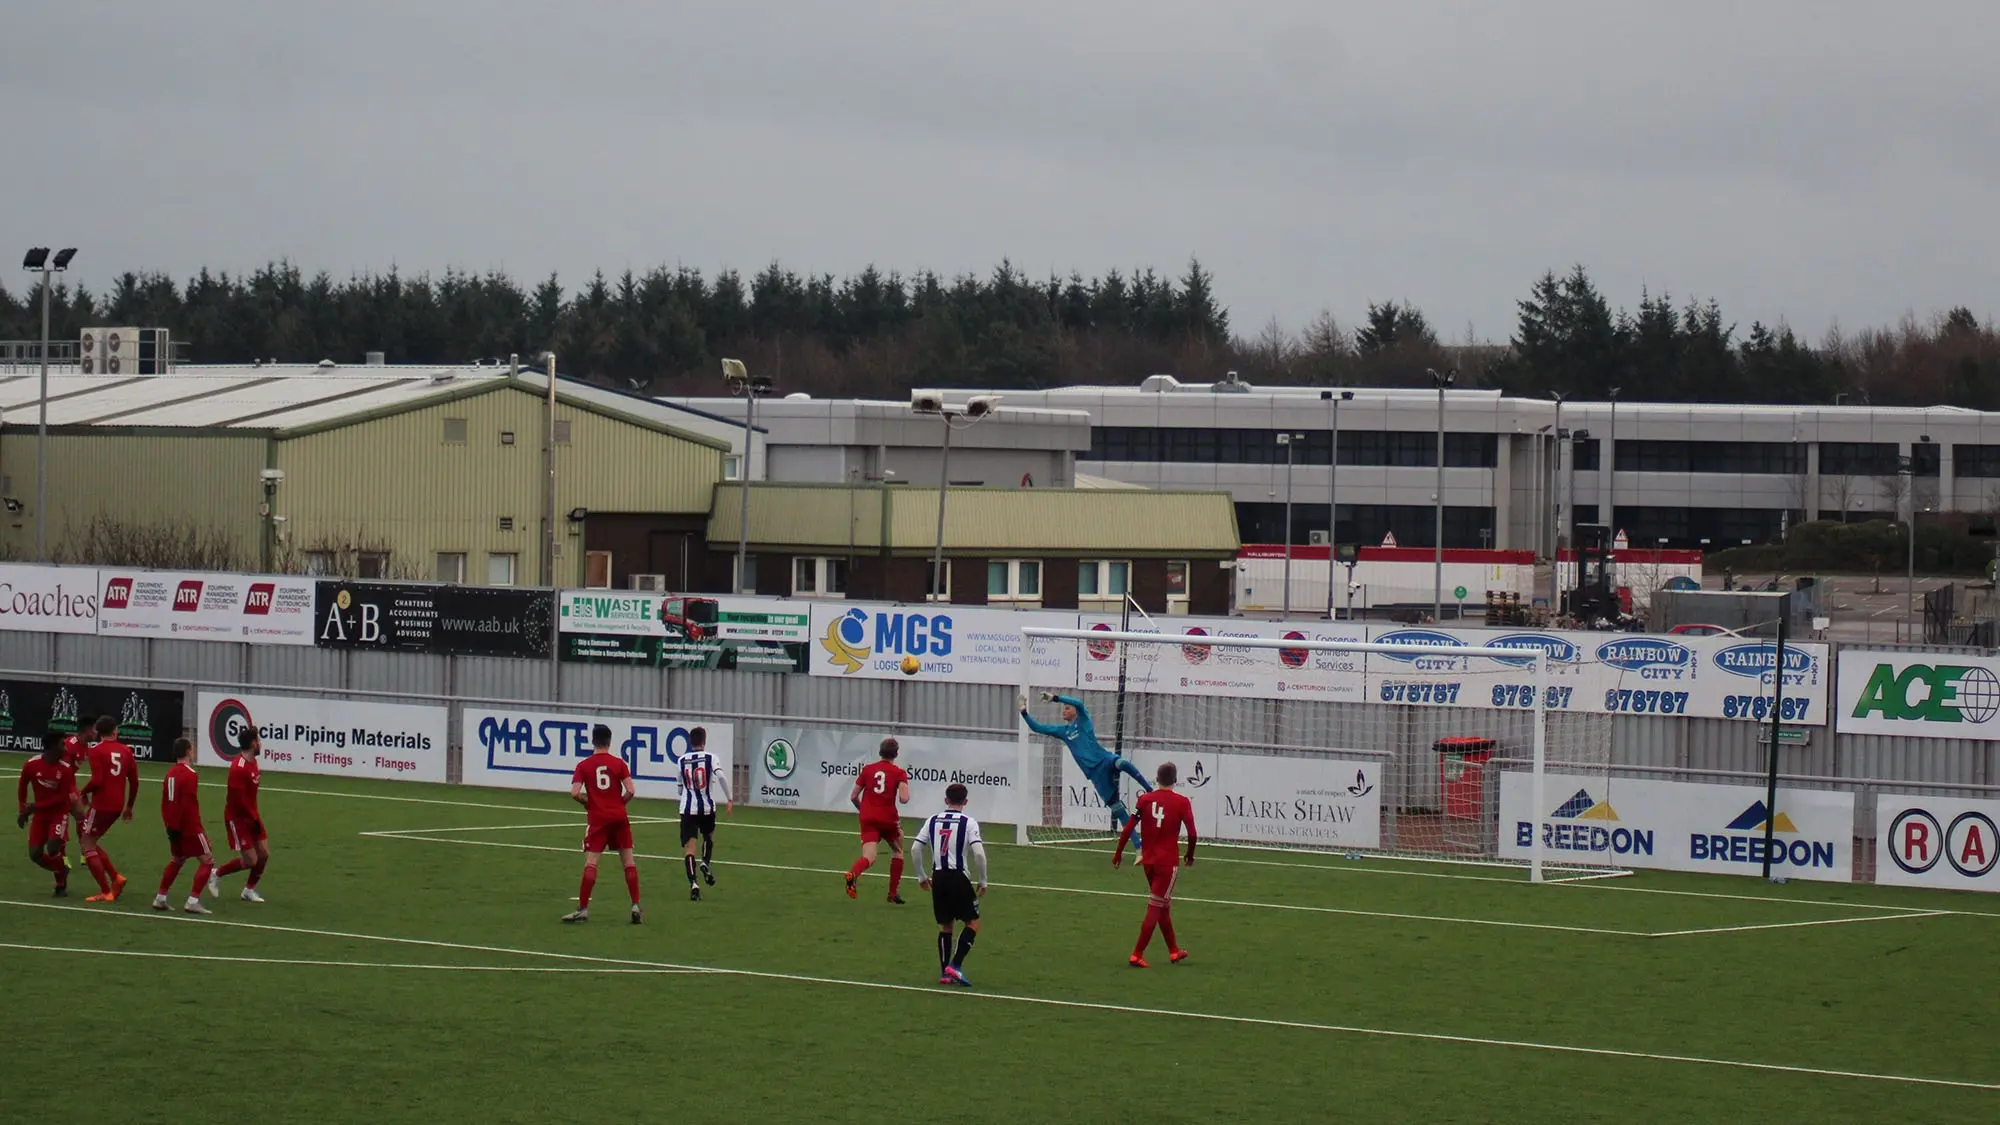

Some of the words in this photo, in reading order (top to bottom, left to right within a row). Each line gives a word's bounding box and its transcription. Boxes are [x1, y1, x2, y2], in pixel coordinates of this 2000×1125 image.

[0, 583, 96, 618] Coaches
[108, 586, 128, 600] ATR
[177, 589, 197, 603] ATR
[248, 592, 269, 606] ATR
[395, 599, 433, 608] CHARTERED
[389, 610, 438, 618] ACCOUNTANTS
[594, 598, 651, 620] WASTE
[396, 629, 430, 638] ADVISORS
[401, 620, 433, 628] BUSINESS
[441, 616, 520, 634] www.aab.uk
[875, 613, 953, 656] MGS
[1315, 659, 1354, 670] Services
[1415, 659, 1456, 670] CITY
[1606, 645, 1681, 662] RAINBOW
[920, 662, 953, 673] LIMITED
[1640, 667, 1684, 679] CITY
[1380, 682, 1461, 704] 878787
[1604, 689, 1689, 714] 878787
[1851, 664, 1971, 723] ACE
[295, 725, 346, 748] Piping
[352, 728, 431, 750] Materials
[478, 717, 595, 762] MASTE
[110, 752, 122, 776] 5
[264, 750, 292, 763] Pipes
[313, 752, 353, 766] Fittings
[375, 756, 416, 772] Flanges
[596, 766, 611, 790] 6
[685, 767, 707, 790] 10
[873, 771, 886, 794] 3
[907, 764, 948, 782] ŠKODA
[951, 770, 1011, 787] Aberdeen.
[761, 785, 800, 797] ŠKODA
[1151, 801, 1165, 828] 4
[1225, 795, 1287, 819] MARK
[1294, 799, 1355, 824] SHAW
[1240, 823, 1288, 836] FUNERAL
[1289, 826, 1338, 839] SERVICES
[939, 829, 952, 857] 7
[1905, 822, 1929, 862] R
[1961, 824, 1986, 865] A
